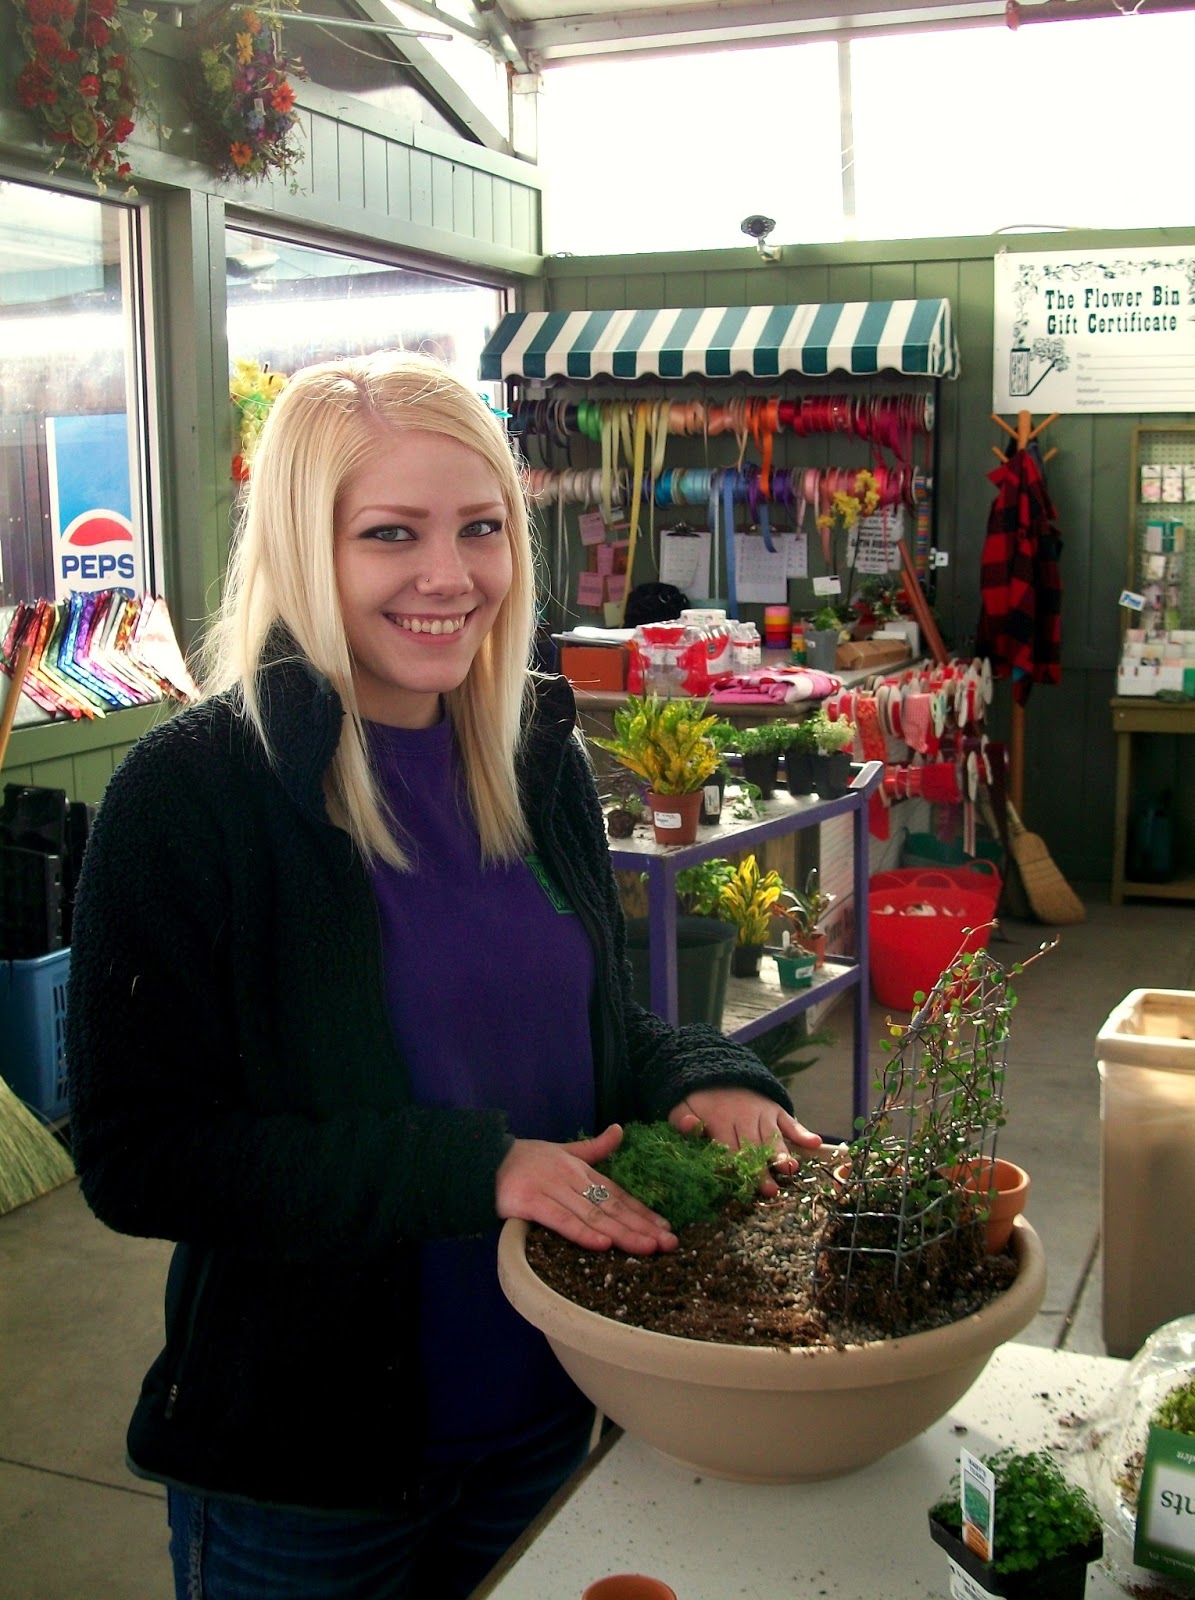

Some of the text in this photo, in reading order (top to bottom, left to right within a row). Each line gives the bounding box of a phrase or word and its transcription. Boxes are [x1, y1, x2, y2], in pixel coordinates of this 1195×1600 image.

[1045, 285, 1180, 310] The Flower Bin
[1047, 312, 1177, 335] Gift Certificate
